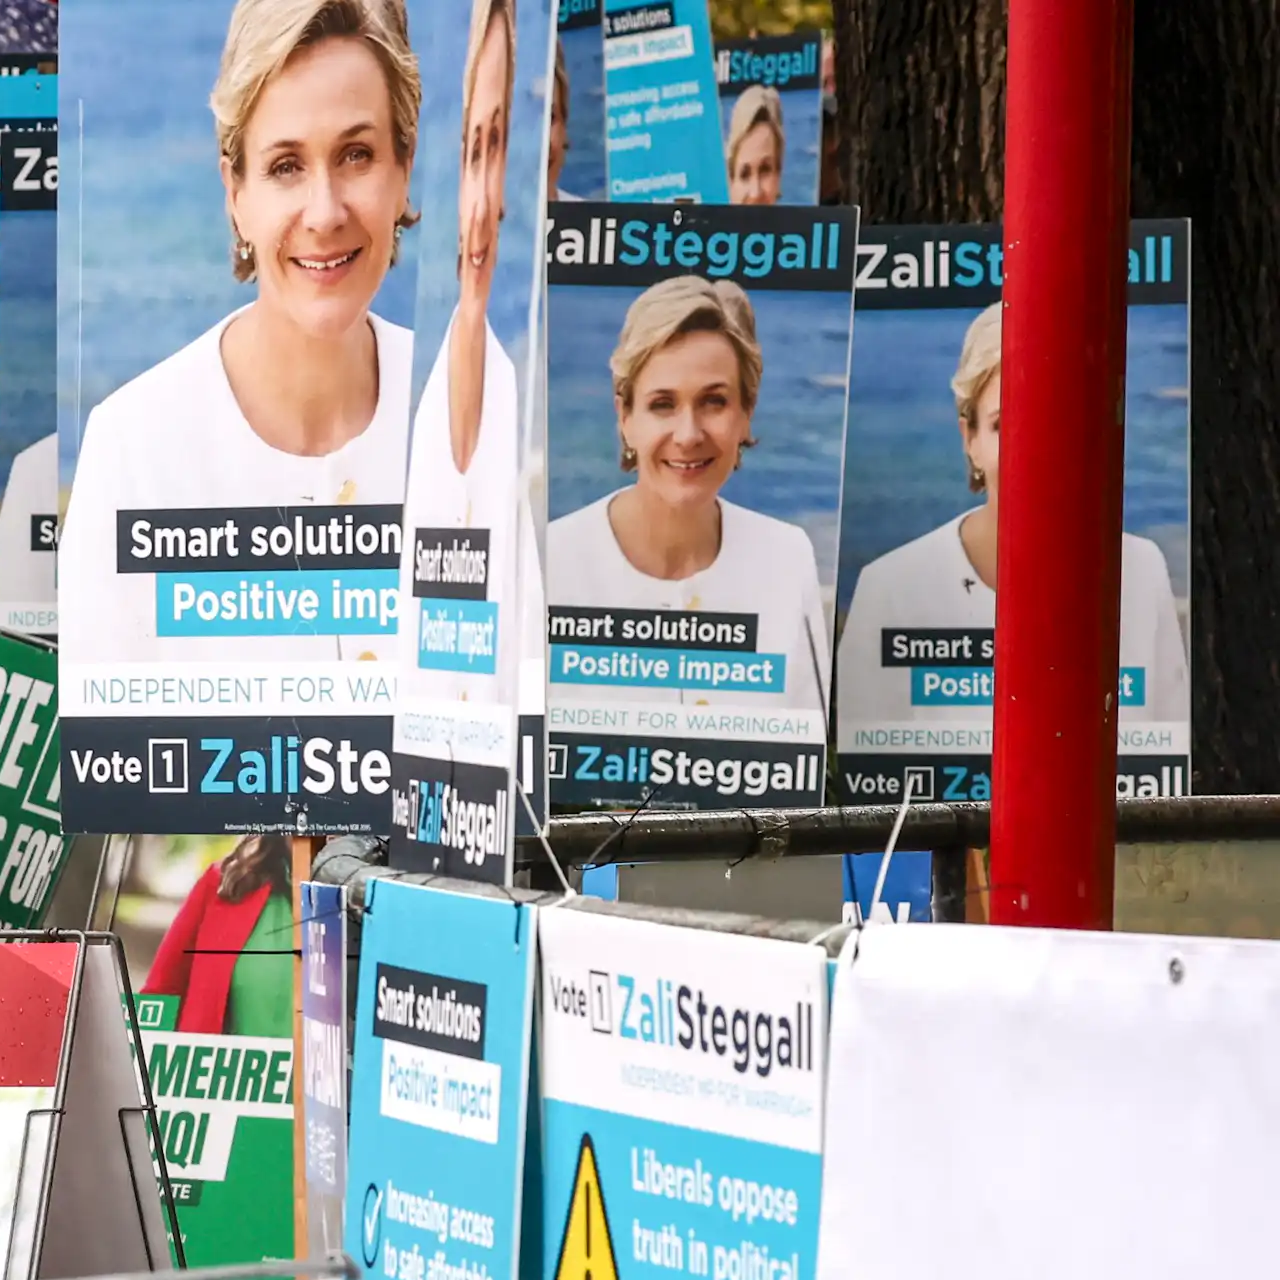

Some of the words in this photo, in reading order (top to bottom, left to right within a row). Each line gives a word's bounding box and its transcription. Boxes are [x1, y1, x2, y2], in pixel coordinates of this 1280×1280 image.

[717, 43, 817, 84] liSteggall
[130, 519, 239, 560] Smart
[415, 540, 441, 582] Smart
[443, 540, 486, 584] solutions
[173, 581, 318, 621] Positive
[421, 608, 457, 654] Positive
[458, 611, 494, 663] impact
[548, 615, 614, 638] mart
[622, 616, 747, 644] solutions
[892, 635, 972, 659] Smart
[563, 652, 669, 678] Positive
[679, 656, 773, 686] impact
[83, 677, 268, 704] INDEPENDENT
[280, 677, 334, 703] FOR
[638, 712, 677, 729] FOR
[687, 715, 809, 735] WARRINGAH
[855, 730, 991, 747] INDEPENDENT
[70, 748, 143, 784] Vote
[575, 746, 818, 796] ZaliSteggall
[845, 772, 900, 794] Vote
[418, 781, 506, 866] ZaliSteggall
[377, 976, 415, 1030] Smart
[416, 985, 482, 1043] solutions
[550, 973, 588, 1018] Vote
[618, 974, 813, 1078] ZaliSteggall
[148, 1043, 293, 1105] MEHRE
[389, 1054, 438, 1107] Positive
[443, 1065, 492, 1124] impact
[631, 1146, 713, 1207] Liberals
[718, 1176, 798, 1225] oppose
[386, 1179, 449, 1244] Increasing
[450, 1203, 495, 1249] access
[384, 1238, 397, 1278] to
[633, 1218, 683, 1270] truth
[688, 1228, 708, 1276] in
